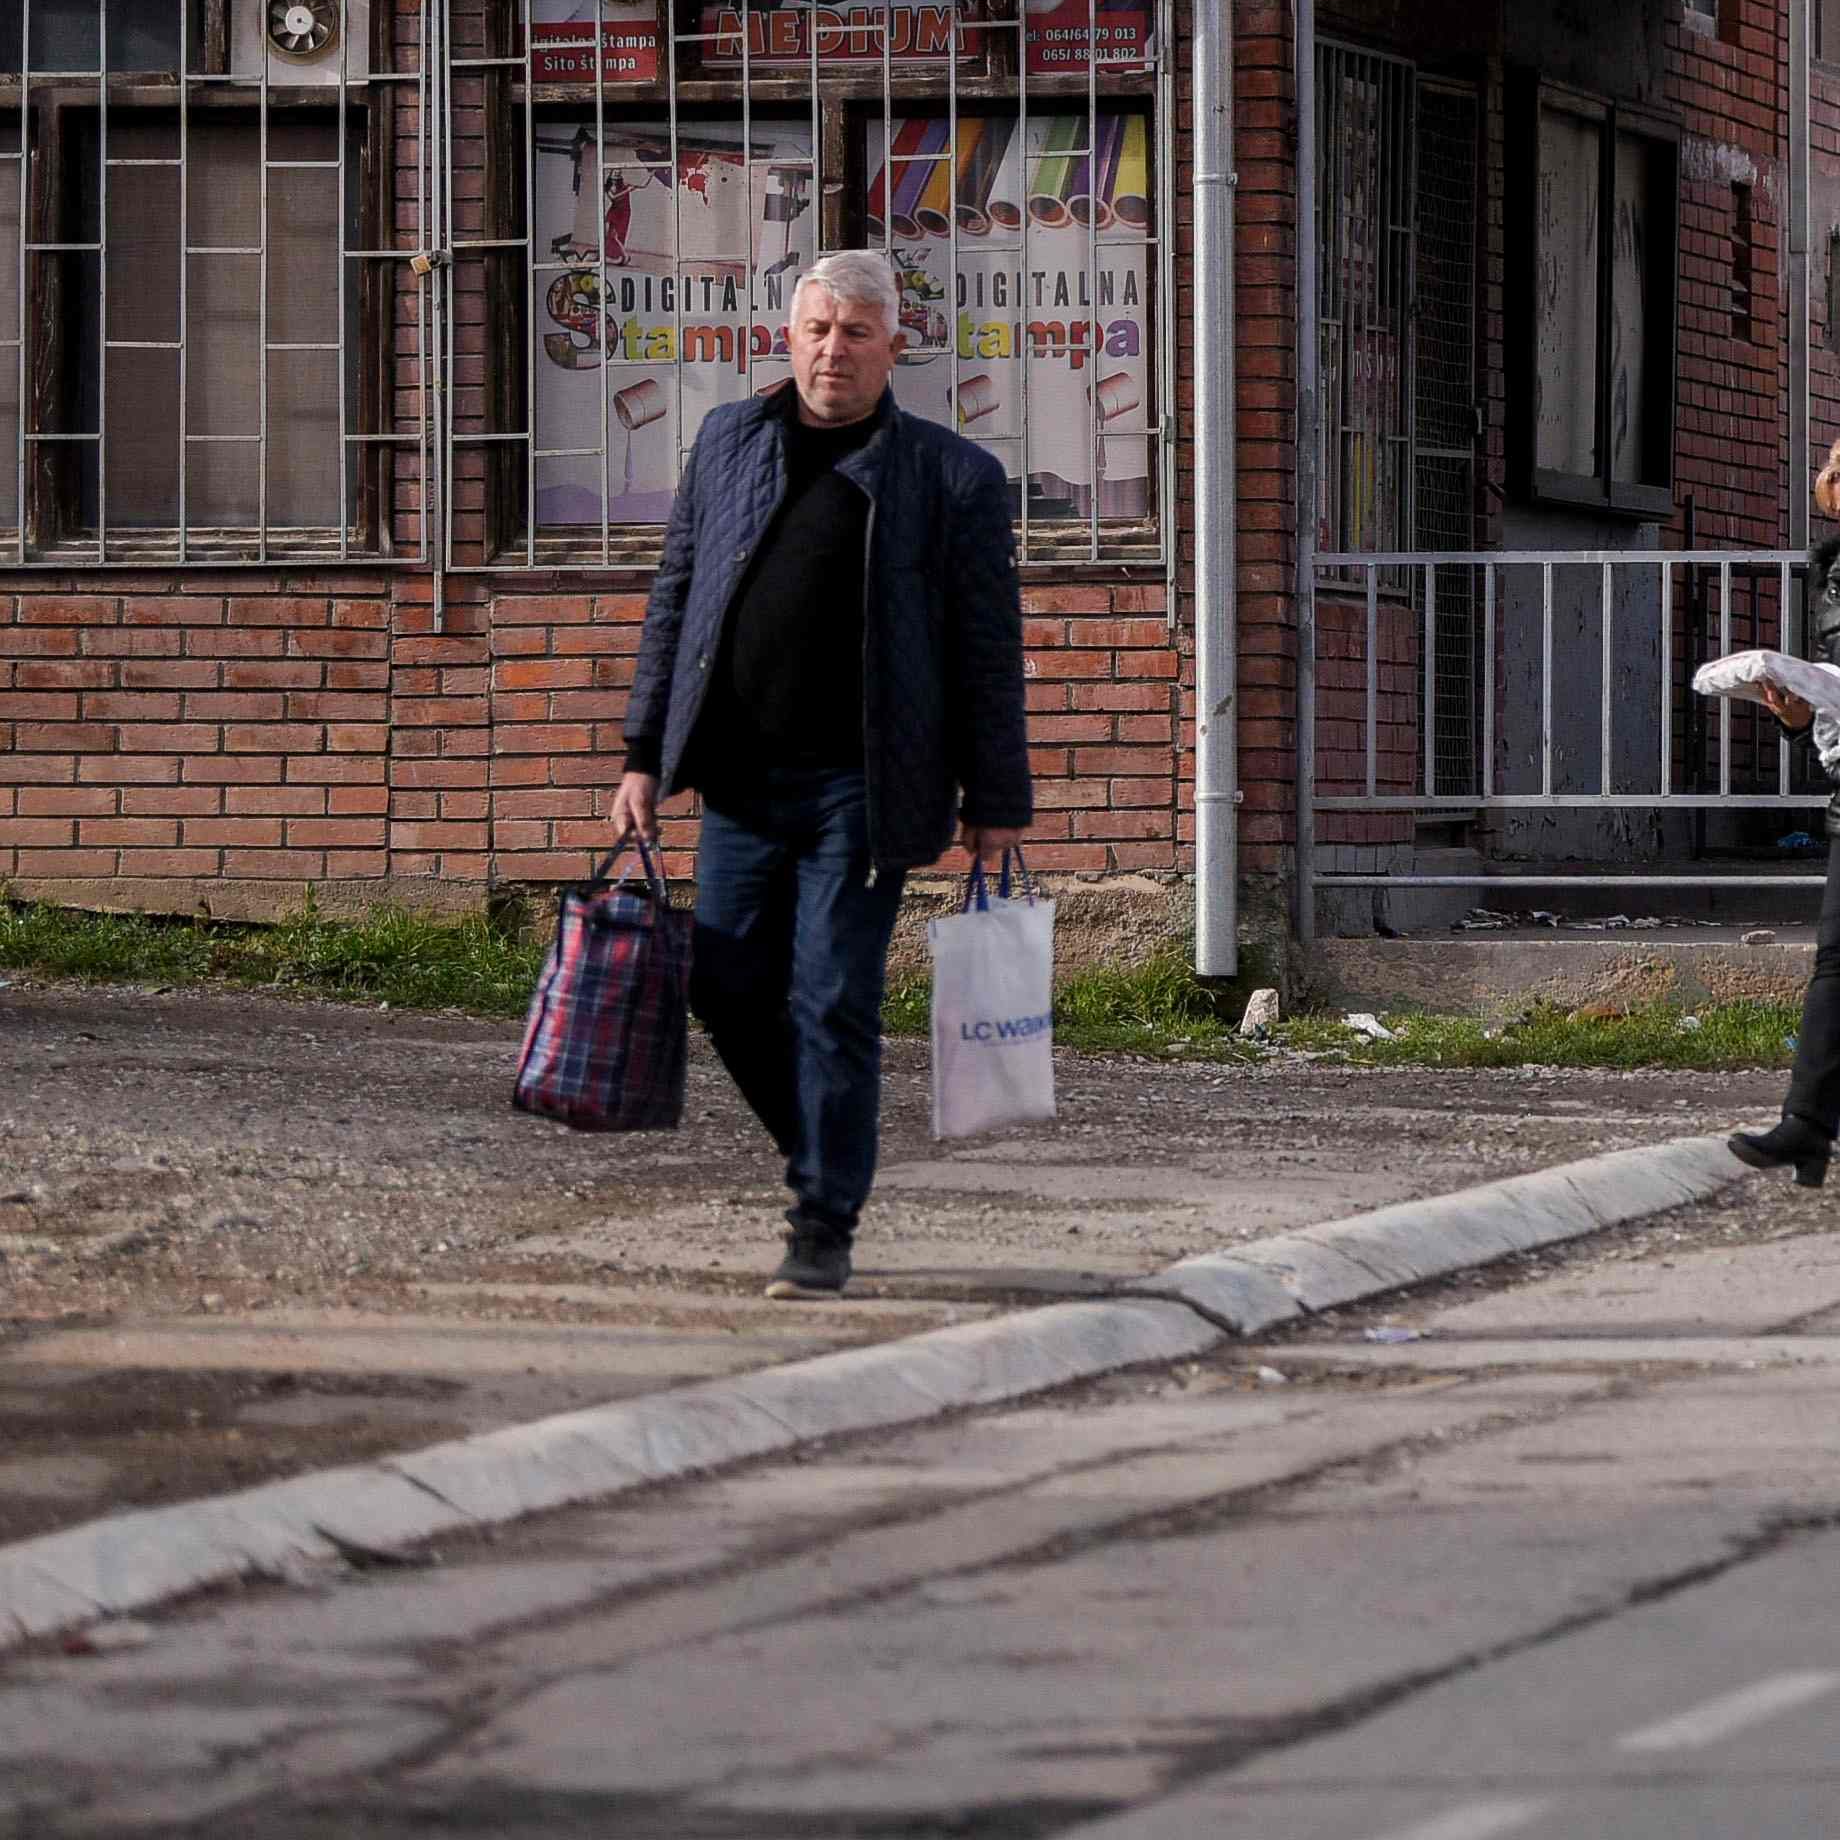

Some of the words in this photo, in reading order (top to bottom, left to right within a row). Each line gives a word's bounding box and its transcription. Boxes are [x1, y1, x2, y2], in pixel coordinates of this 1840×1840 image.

[715, 7, 966, 56] MEDIUM
[544, 56, 575, 70] Sito
[581, 53, 636, 71] štmpa
[956, 270, 1139, 309] DIGITALNA
[960, 1021, 992, 1042] LC
